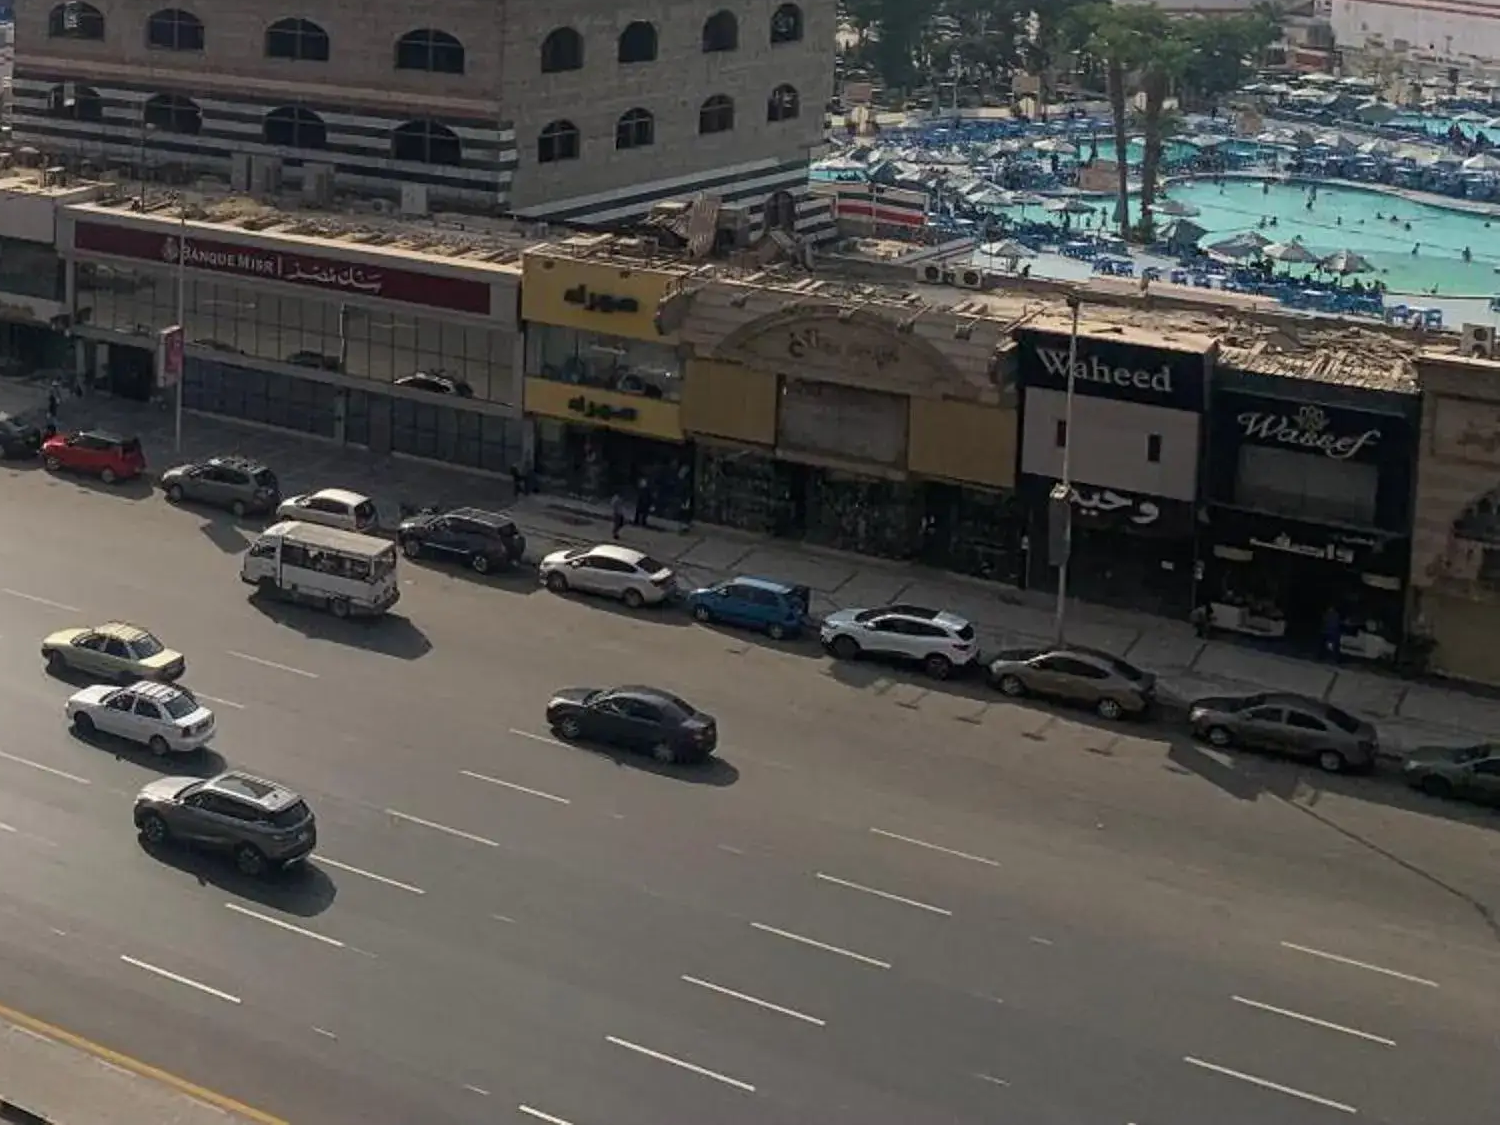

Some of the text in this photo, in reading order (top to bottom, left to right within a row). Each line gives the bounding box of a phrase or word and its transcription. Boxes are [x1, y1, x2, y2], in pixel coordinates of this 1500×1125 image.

[182, 243, 275, 276] BANQUE MISR
[1036, 347, 1172, 392] Waheed
[1237, 412, 1381, 460] Wassef
